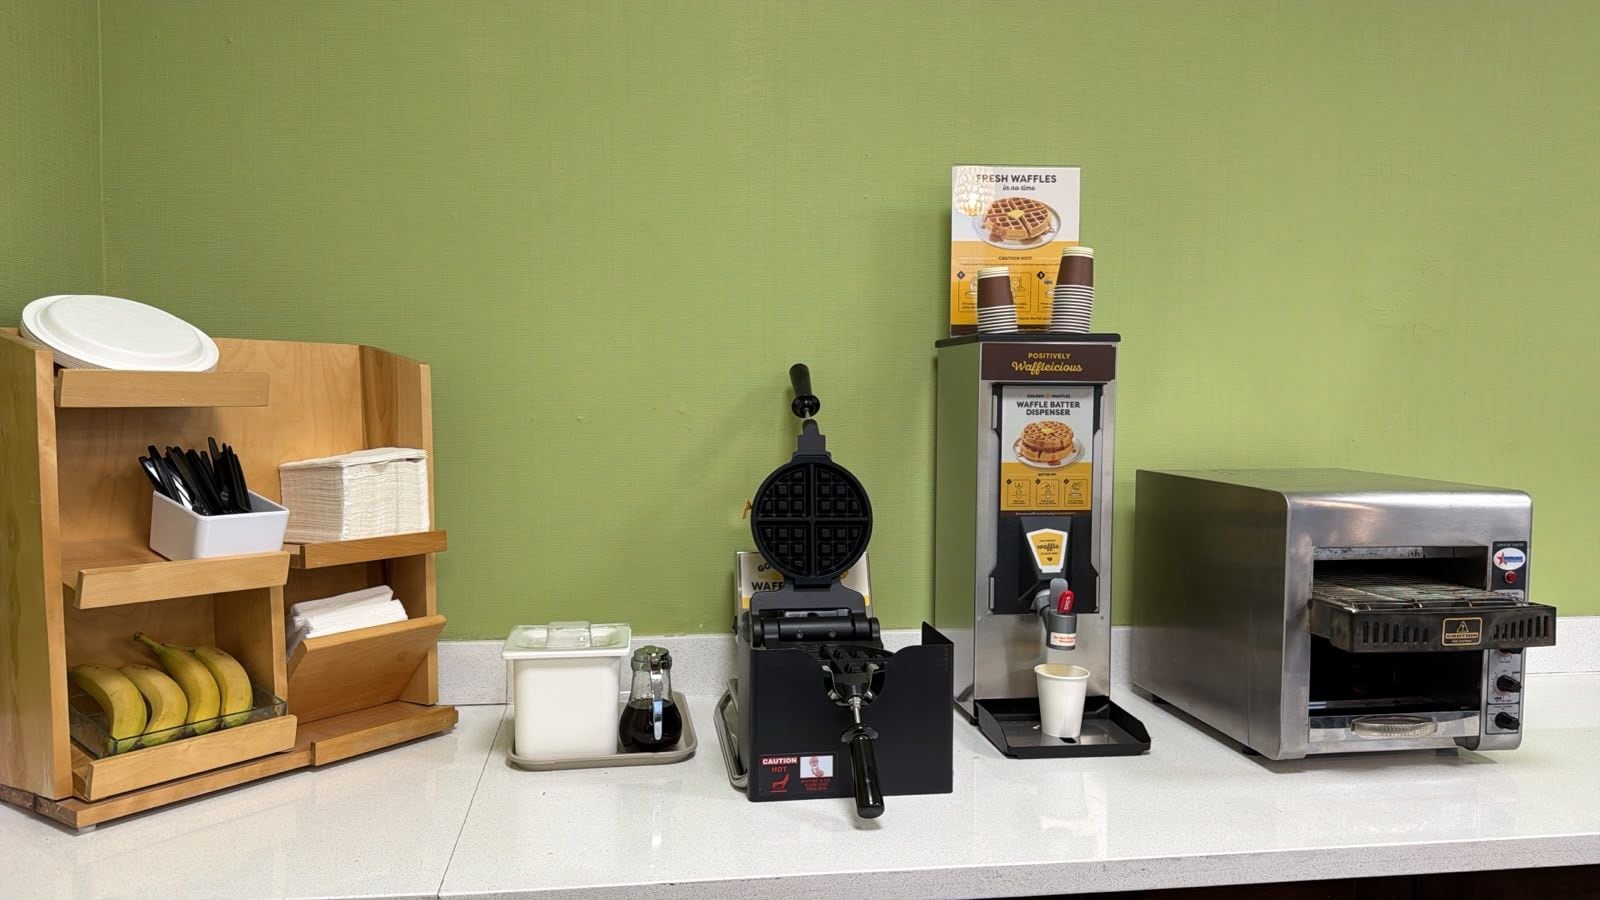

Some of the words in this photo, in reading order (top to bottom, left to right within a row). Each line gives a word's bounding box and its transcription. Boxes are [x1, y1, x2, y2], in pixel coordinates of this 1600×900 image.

[976, 174, 1008, 183] FRESH
[1011, 174, 1057, 183] WAFFLES
[1026, 408, 1071, 416] DISPENSER
[751, 582, 784, 591] WAFF
[762, 757, 798, 765] CAUTION
